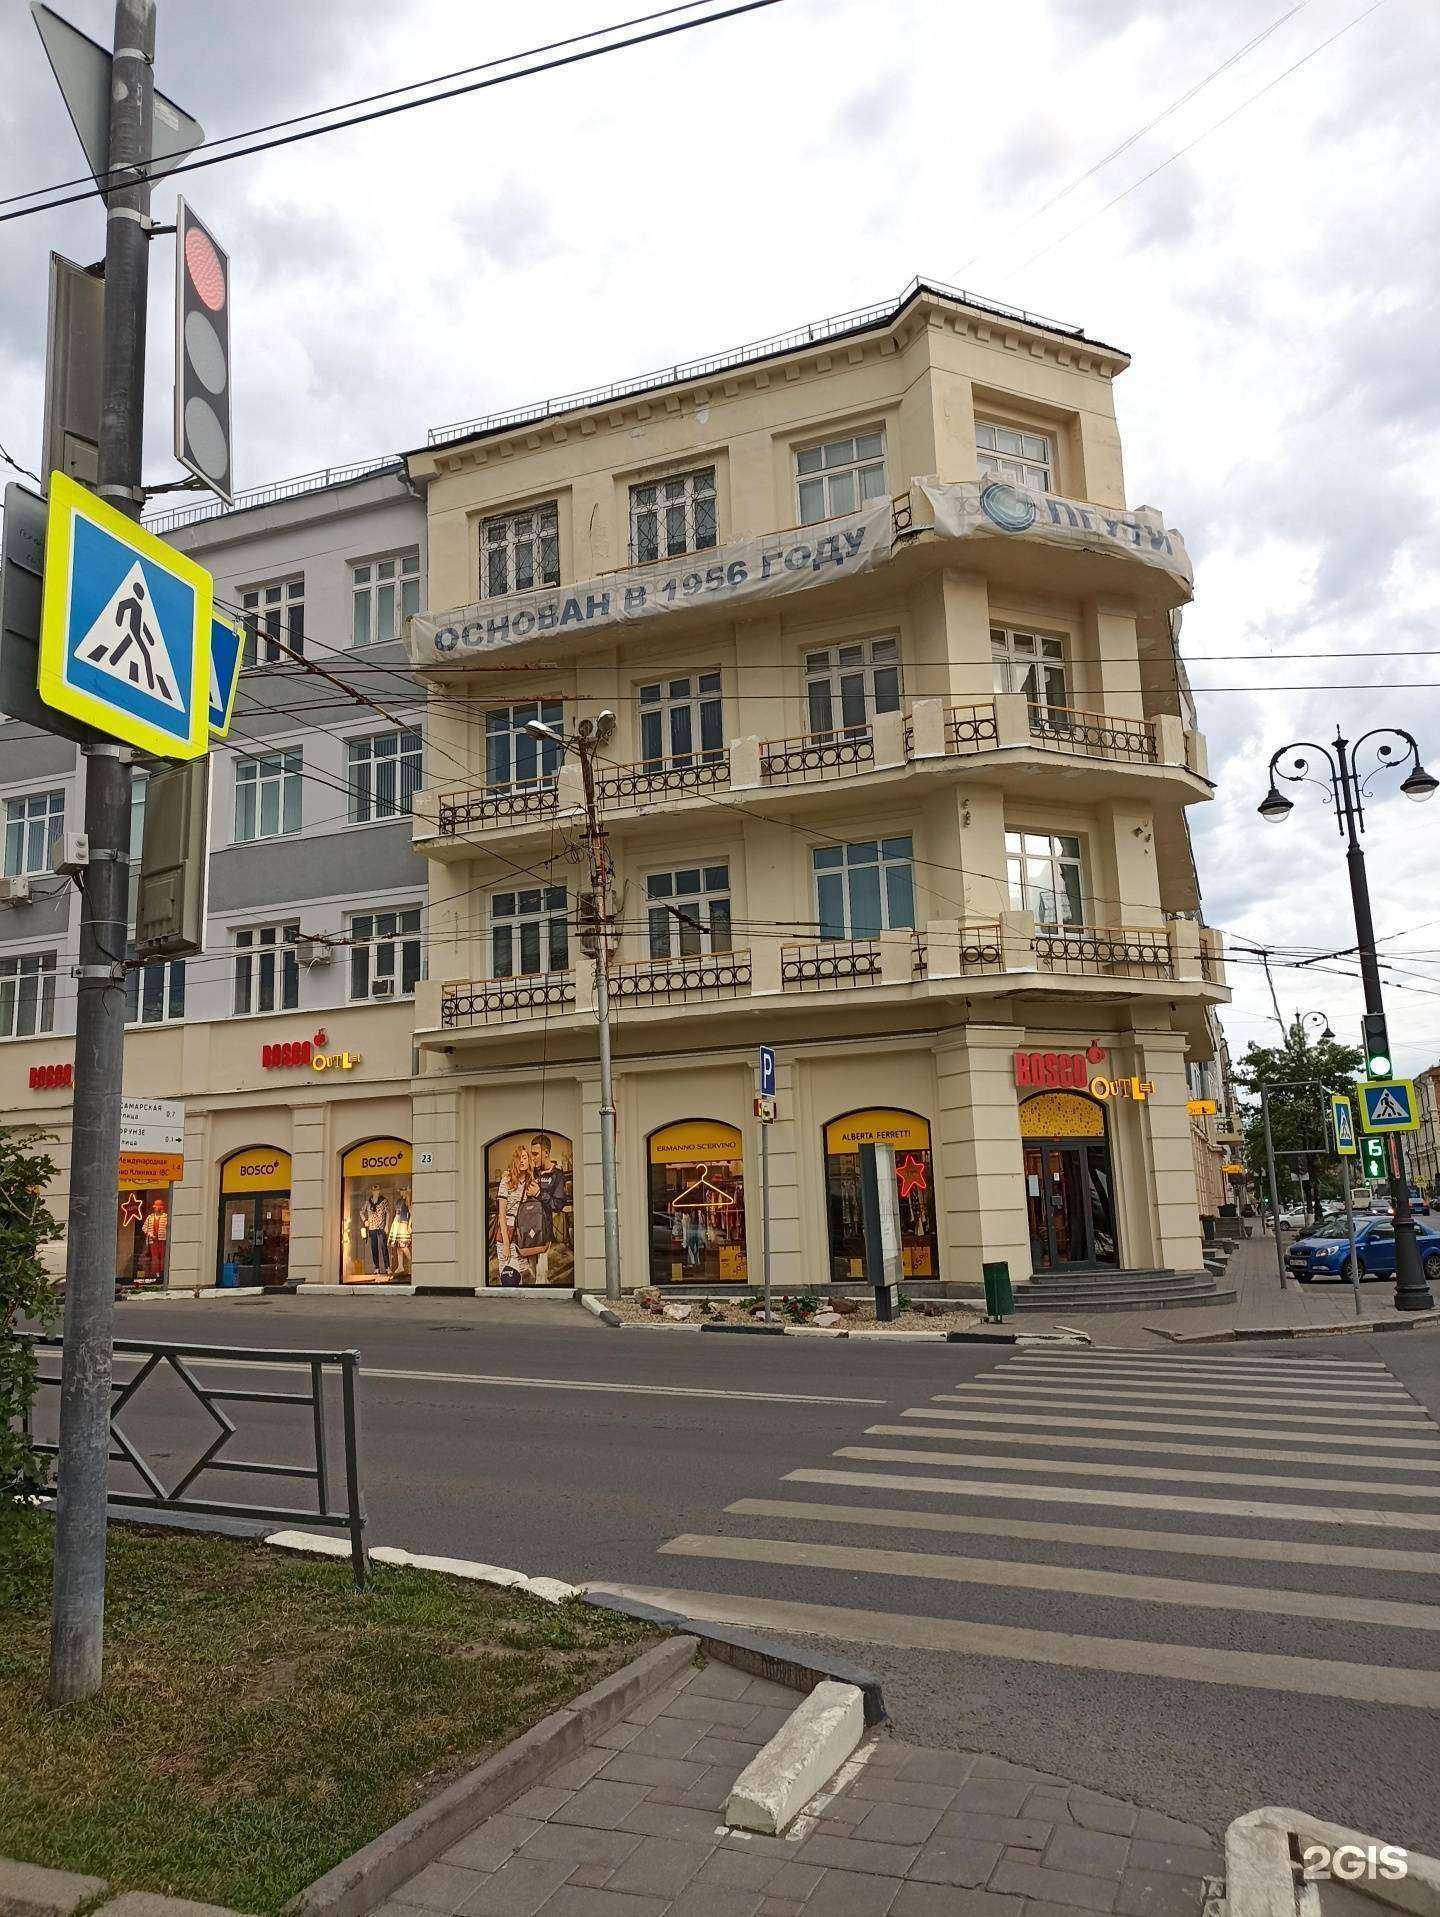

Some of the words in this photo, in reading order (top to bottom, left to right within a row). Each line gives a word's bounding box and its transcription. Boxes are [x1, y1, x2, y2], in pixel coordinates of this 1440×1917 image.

[434, 592, 611, 652] ОСНОВАН
[623, 585, 648, 610] В
[662, 560, 748, 602] 1956
[761, 526, 866, 579] ГОДУ
[763, 1052, 772, 1089] P
[1014, 1052, 1088, 1088] BOSCO
[842, 1131, 874, 1141] ALBERTA
[877, 1129, 911, 1139] FERRETTI
[656, 1144, 695, 1152] ERMANNO
[362, 1156, 398, 1169] BOSCO
[421, 1154, 432, 1163] 23
[240, 1164, 275, 1177] BOSCO
